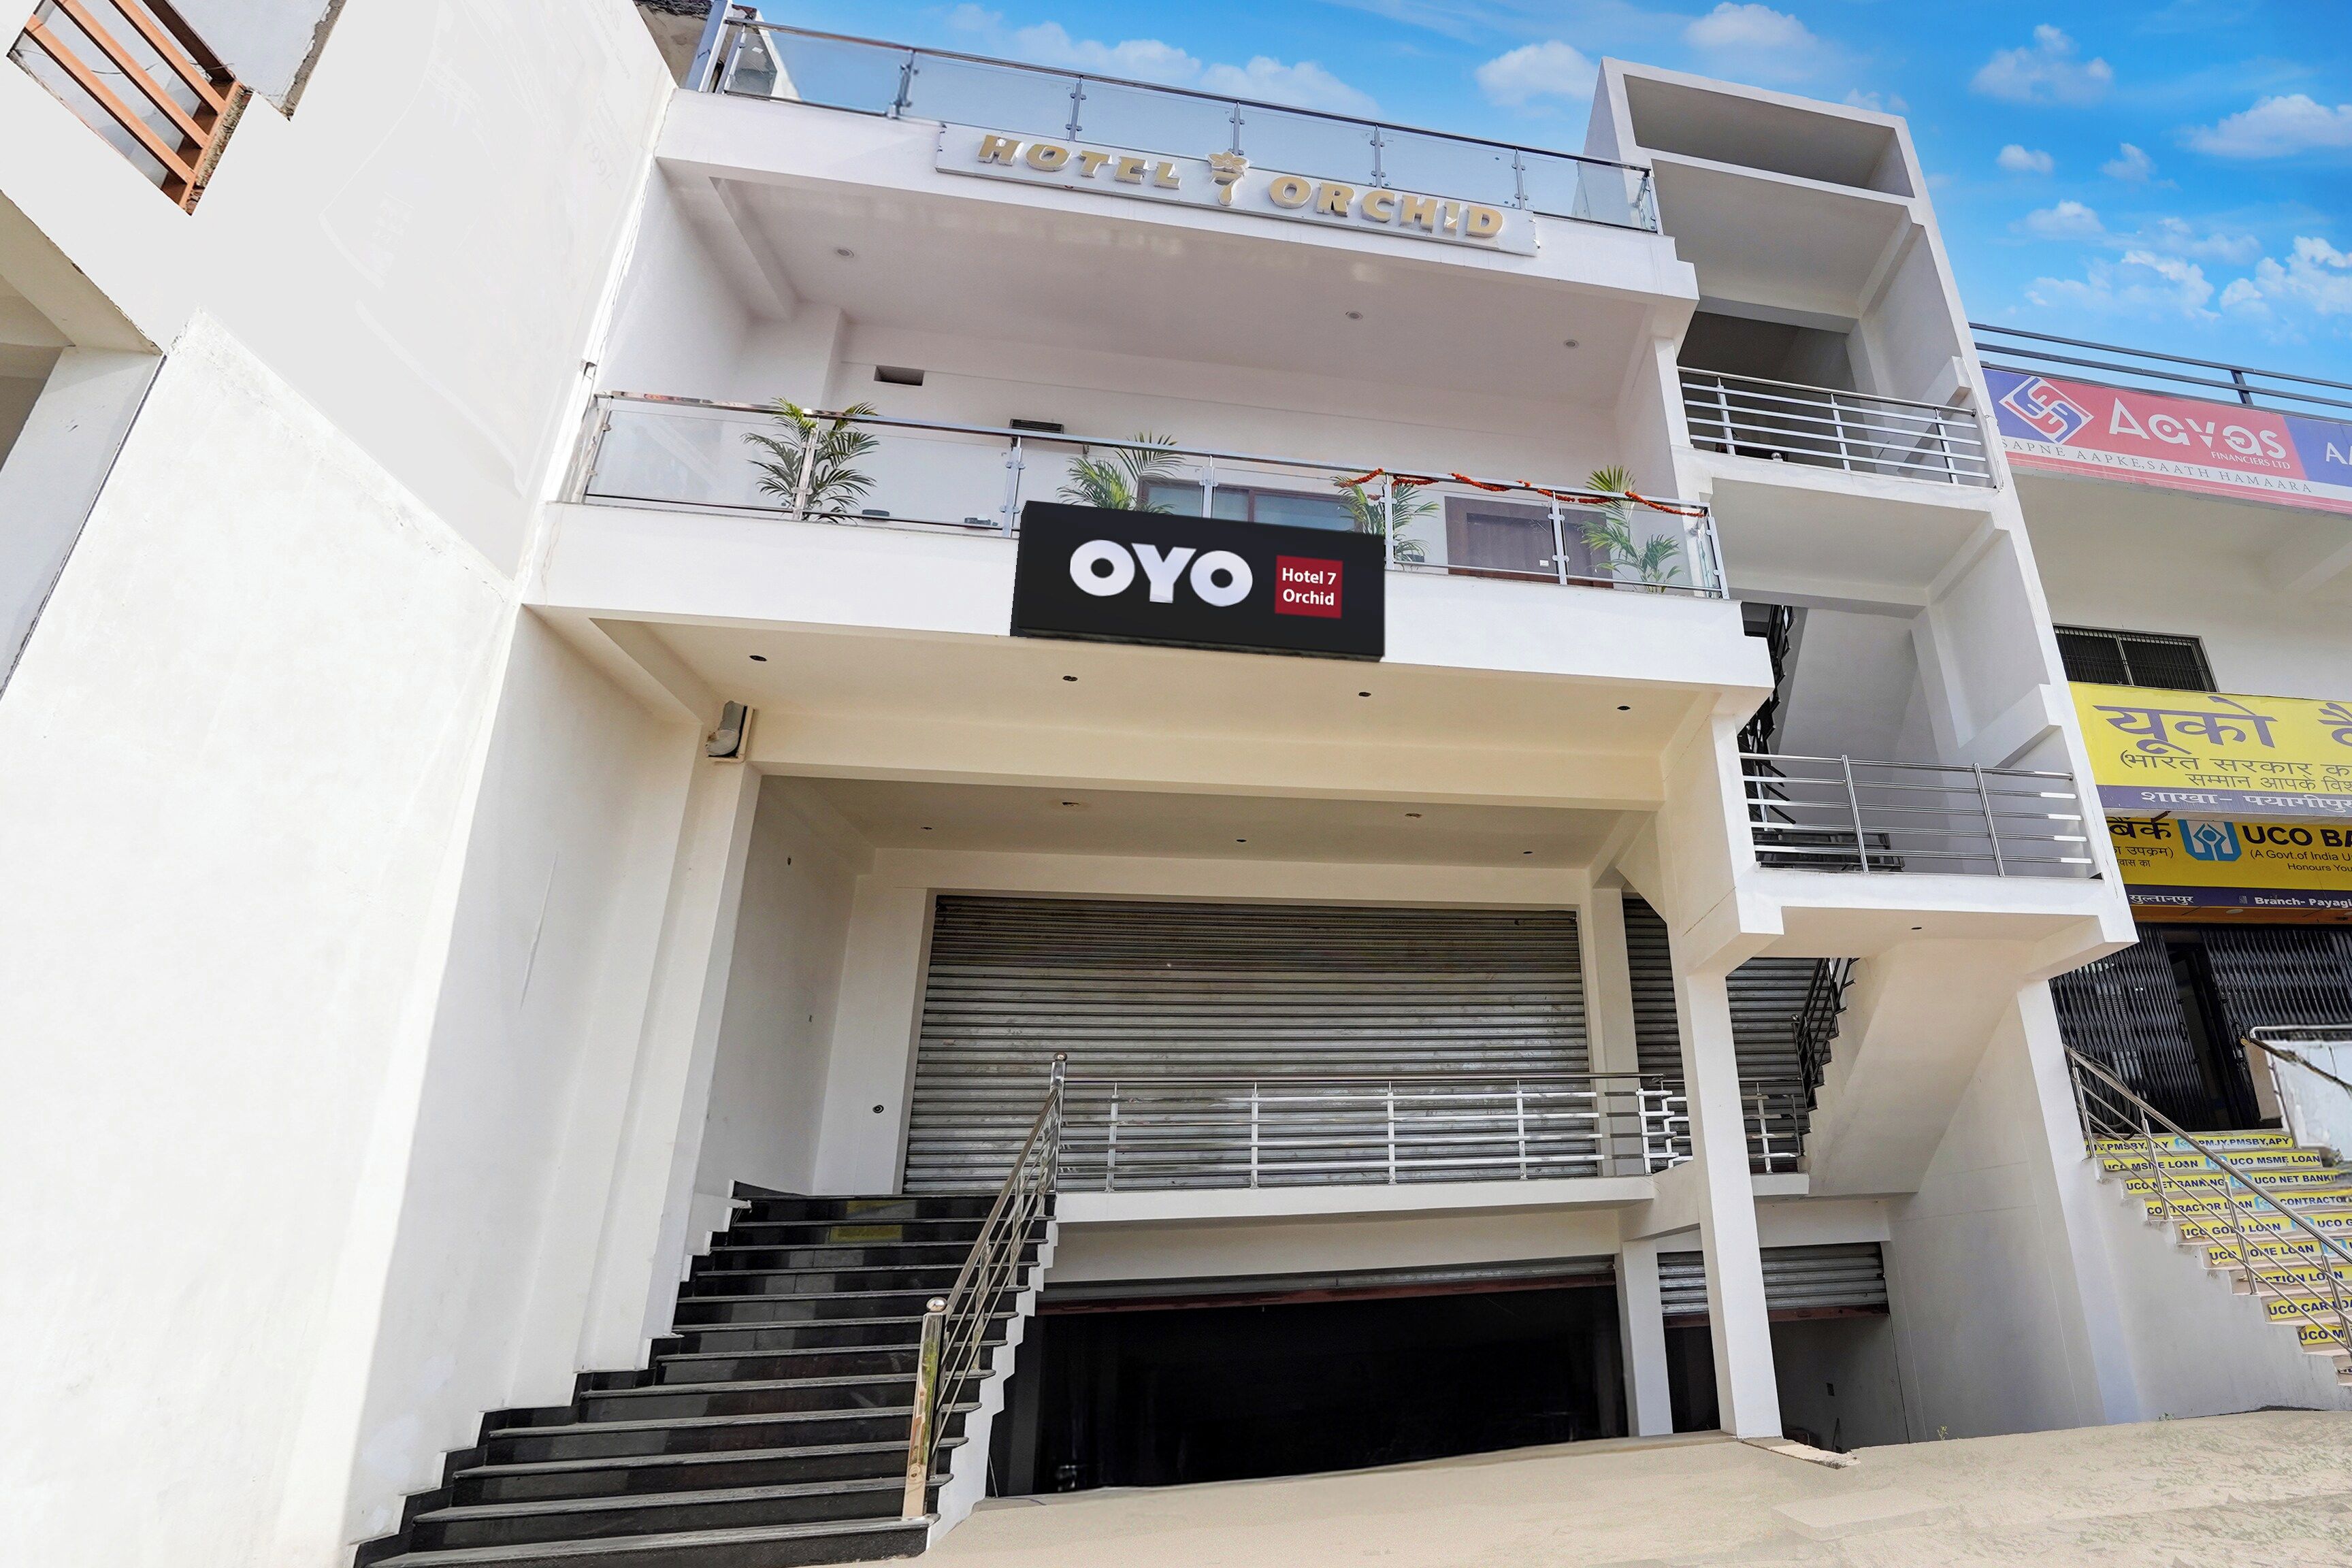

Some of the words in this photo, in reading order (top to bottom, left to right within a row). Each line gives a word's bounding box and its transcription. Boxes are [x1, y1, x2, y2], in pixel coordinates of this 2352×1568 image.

[976, 134, 1181, 190] HOTEL
[1269, 175, 1504, 239] ORCHID
[2002, 438, 2066, 457] SAPNE
[2220, 470, 2313, 494] HAMAARA
[2211, 450, 2270, 468] FINANCIERS
[2272, 459, 2291, 470] LTD
[1069, 539, 1254, 608] OYO
[1281, 568, 1324, 585] Hotel
[1327, 572, 1337, 586] 7
[1283, 588, 1335, 606] Orchid
[2093, 696, 2278, 755] यूको
[2120, 750, 2200, 770] (भारत
[2209, 758, 2313, 777] सरकार
[2185, 773, 2251, 789] सम्मान
[2260, 774, 2316, 791] आपके
[2242, 826, 2313, 846] UCO
[2311, 851, 2339, 861] India
[2287, 863, 2332, 872] Honours
[2230, 1158, 2253, 1166] UCO
[2147, 1203, 2221, 1215] COTRACTOR
[2317, 1219, 2342, 1228] UCO
[2247, 1247, 2278, 1258] OME
[2269, 1305, 2297, 1316] UCO
[2301, 1303, 2330, 1313] CAR
[2299, 1330, 2329, 1341] UCO
